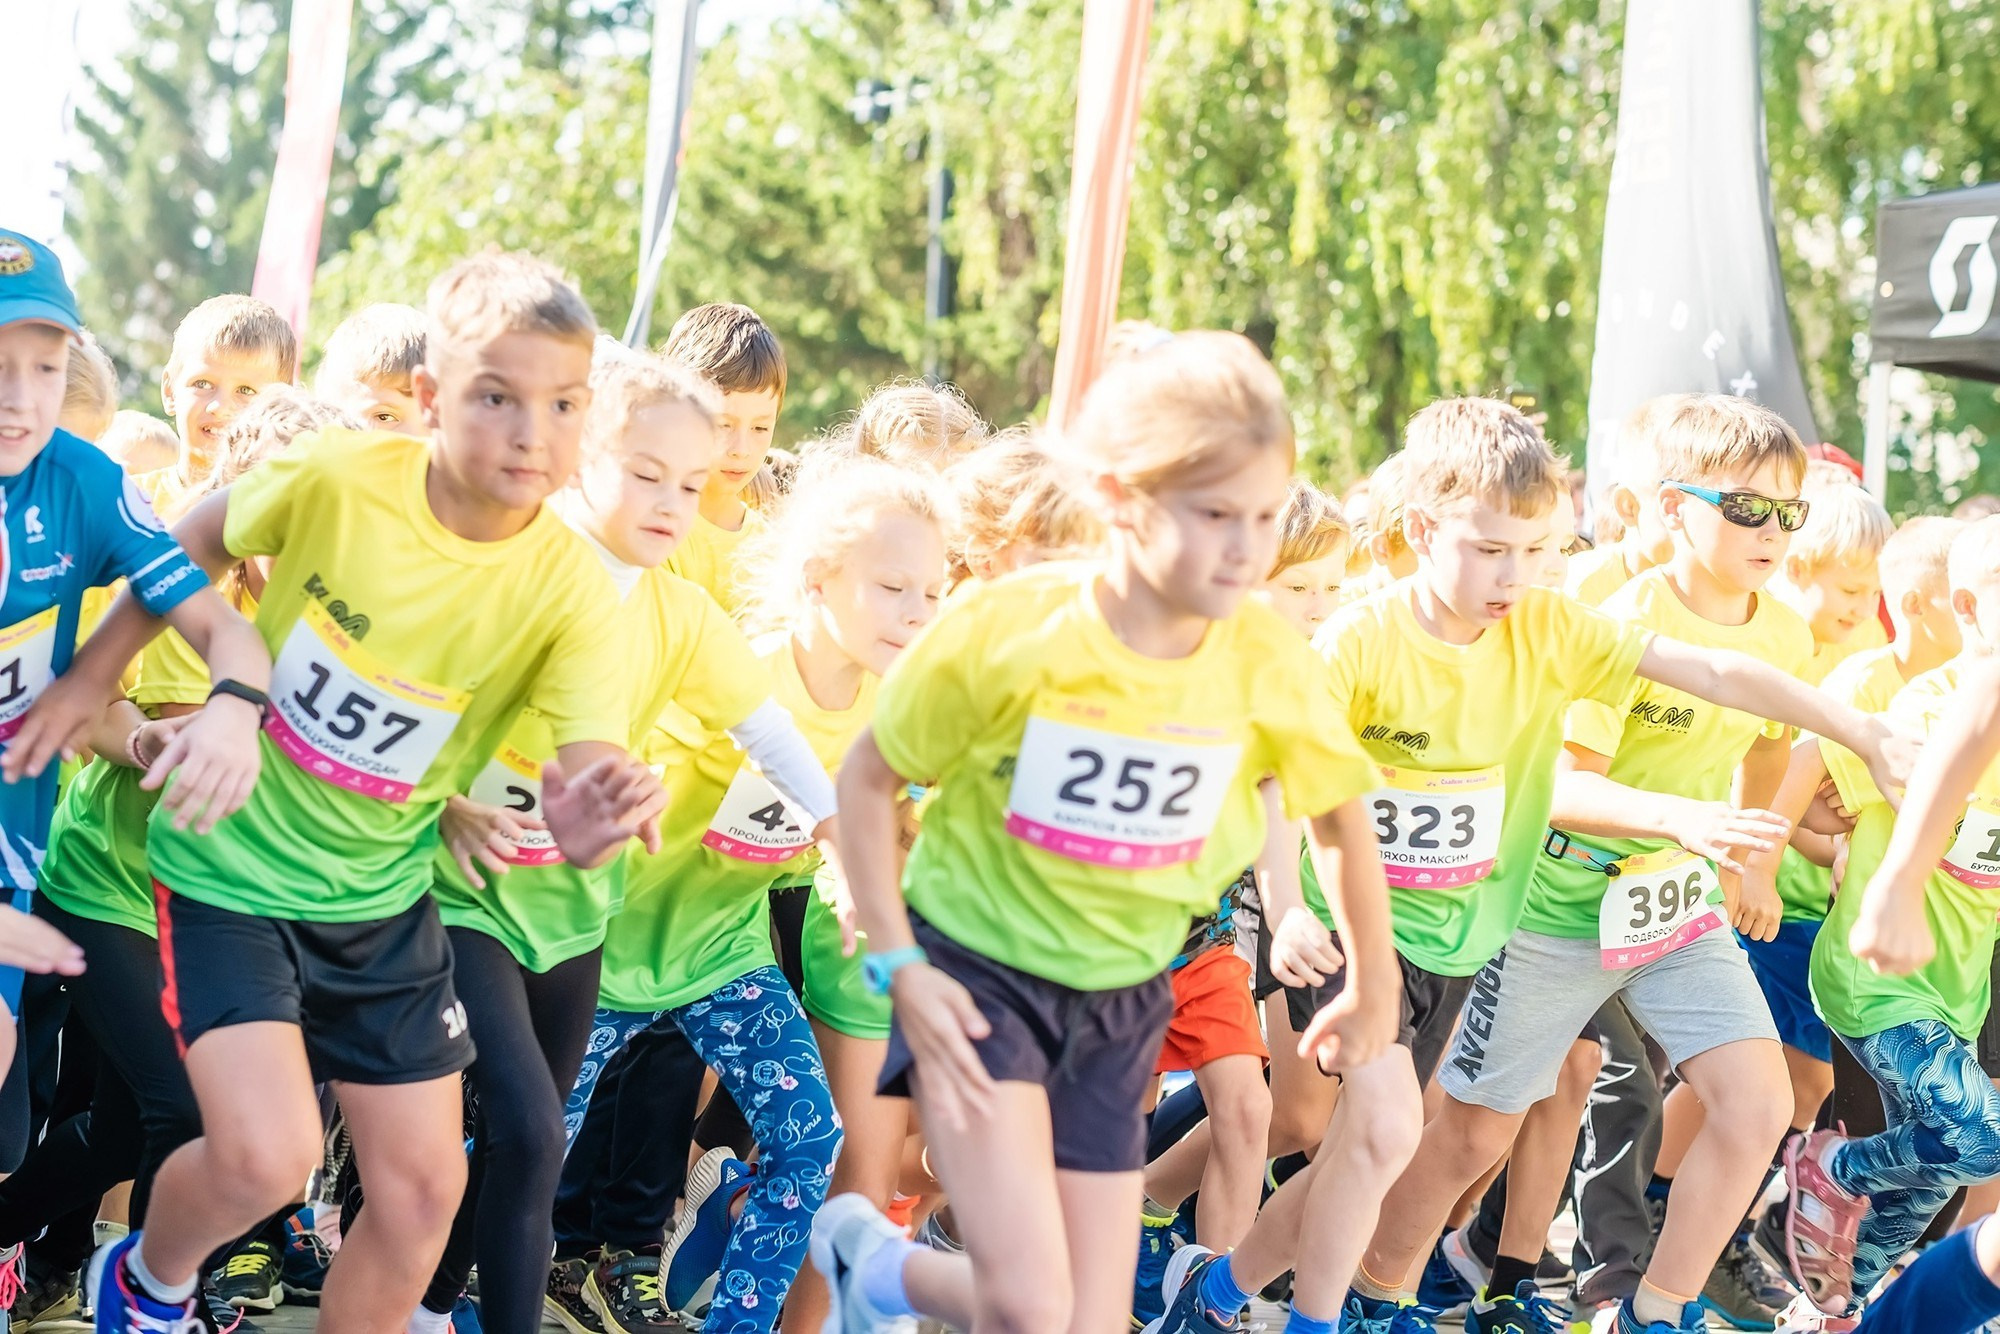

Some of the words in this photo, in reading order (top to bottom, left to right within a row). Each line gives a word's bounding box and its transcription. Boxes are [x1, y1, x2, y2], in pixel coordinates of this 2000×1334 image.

[295, 661, 420, 754] 157
[1058, 749, 1200, 816] 252
[728, 826, 800, 845] ПРОЦЫКОВА
[1373, 799, 1475, 849] 323
[1419, 853, 1469, 864] МАКСИМ
[1628, 871, 1702, 928] 396
